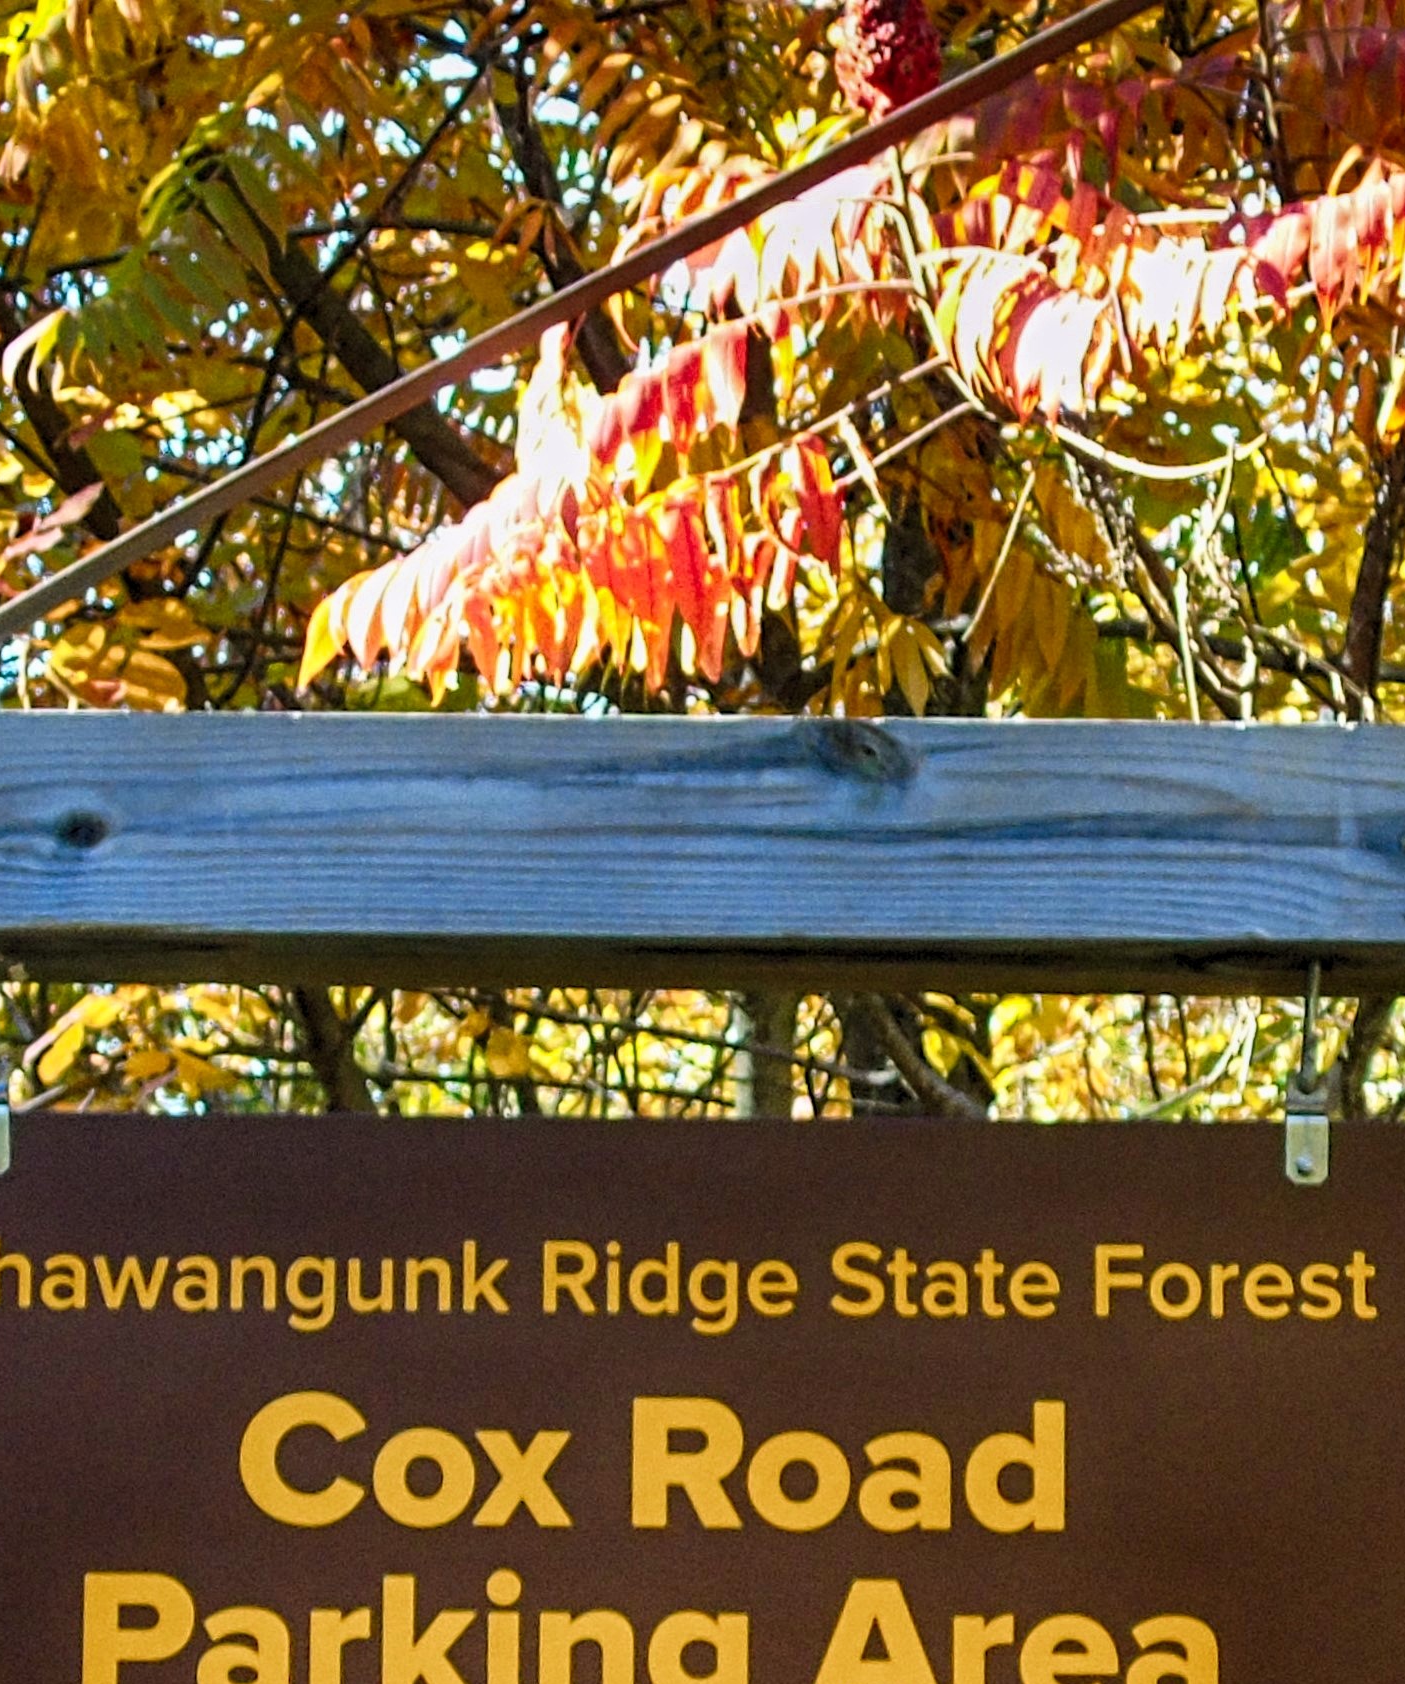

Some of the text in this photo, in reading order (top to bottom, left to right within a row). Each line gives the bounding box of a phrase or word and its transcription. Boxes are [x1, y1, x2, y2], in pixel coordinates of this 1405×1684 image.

[542, 1239, 799, 1335] Ridge
[829, 1240, 1062, 1320] State
[1094, 1242, 1378, 1321] Forest
[238, 1391, 1066, 1534] Cox Road
